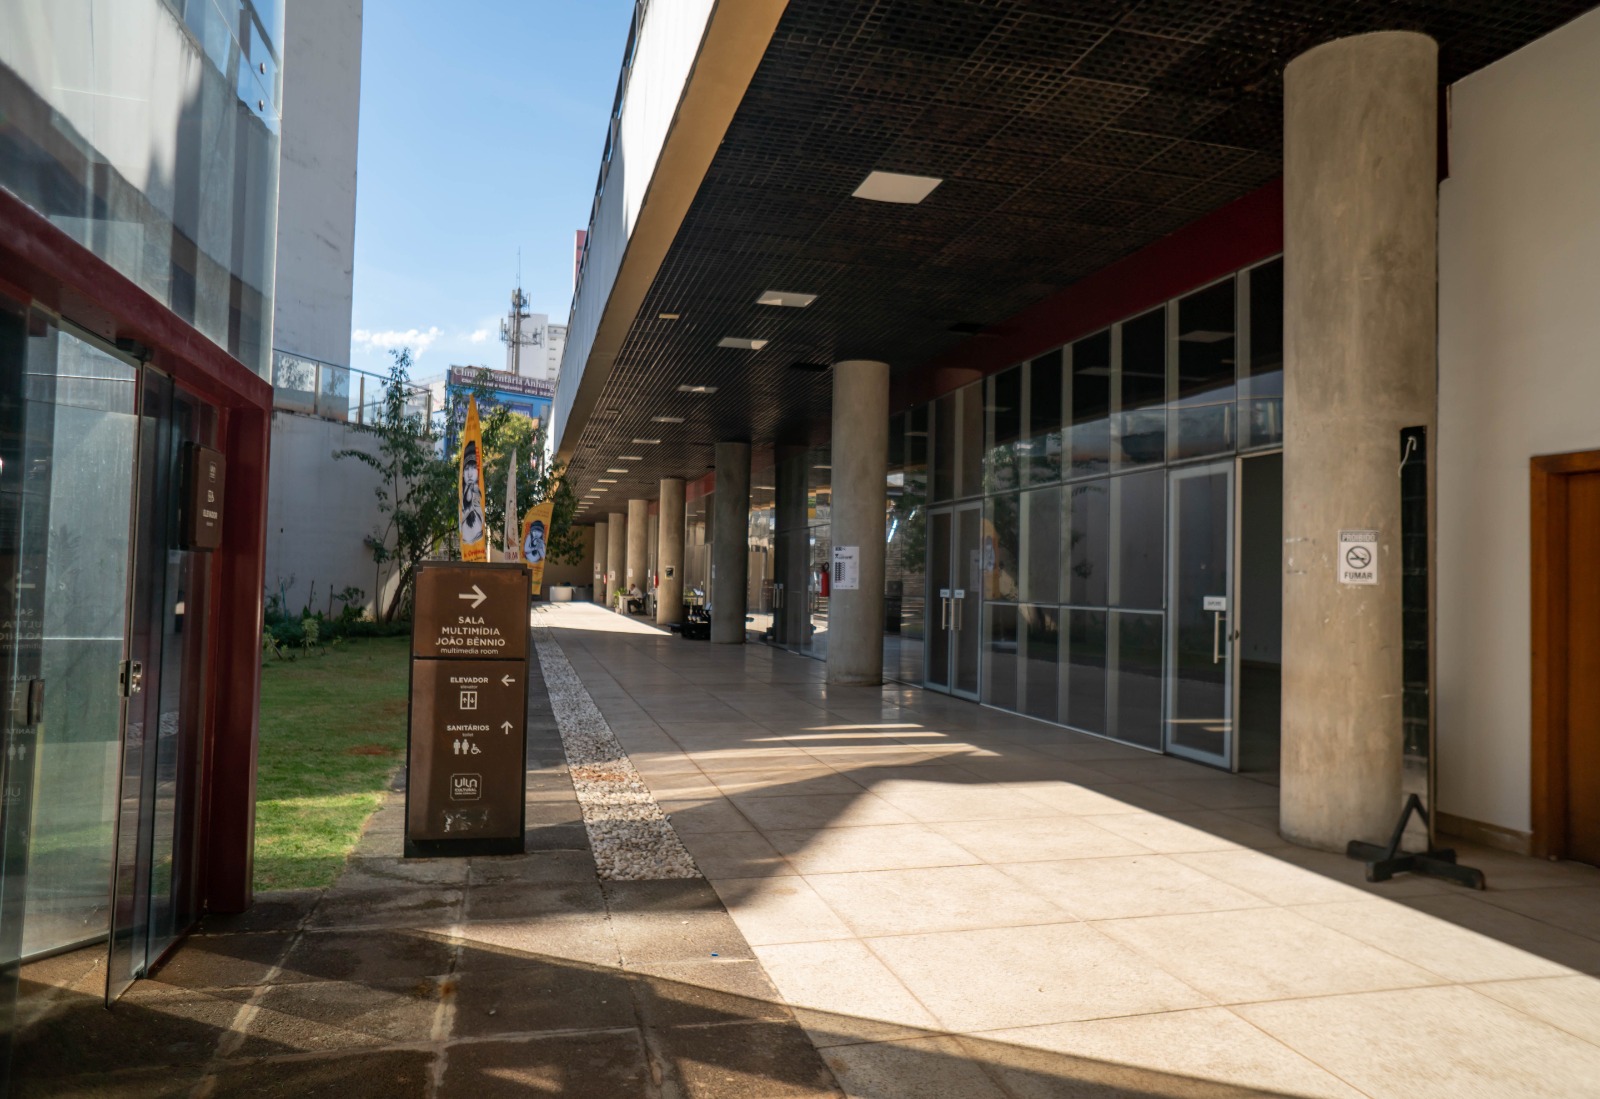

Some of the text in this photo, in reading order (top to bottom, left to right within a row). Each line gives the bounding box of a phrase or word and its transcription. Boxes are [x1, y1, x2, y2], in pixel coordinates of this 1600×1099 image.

[1342, 533, 1376, 542] PROIBIDO
[1344, 571, 1373, 580] FUMAR
[458, 616, 485, 625] SALA
[441, 626, 501, 636] MULTIMÍDIA
[435, 636, 506, 647] JOÃO BÊNNIO
[440, 647, 479, 655] multimedia
[446, 724, 490, 732] SANITÁRIOS
